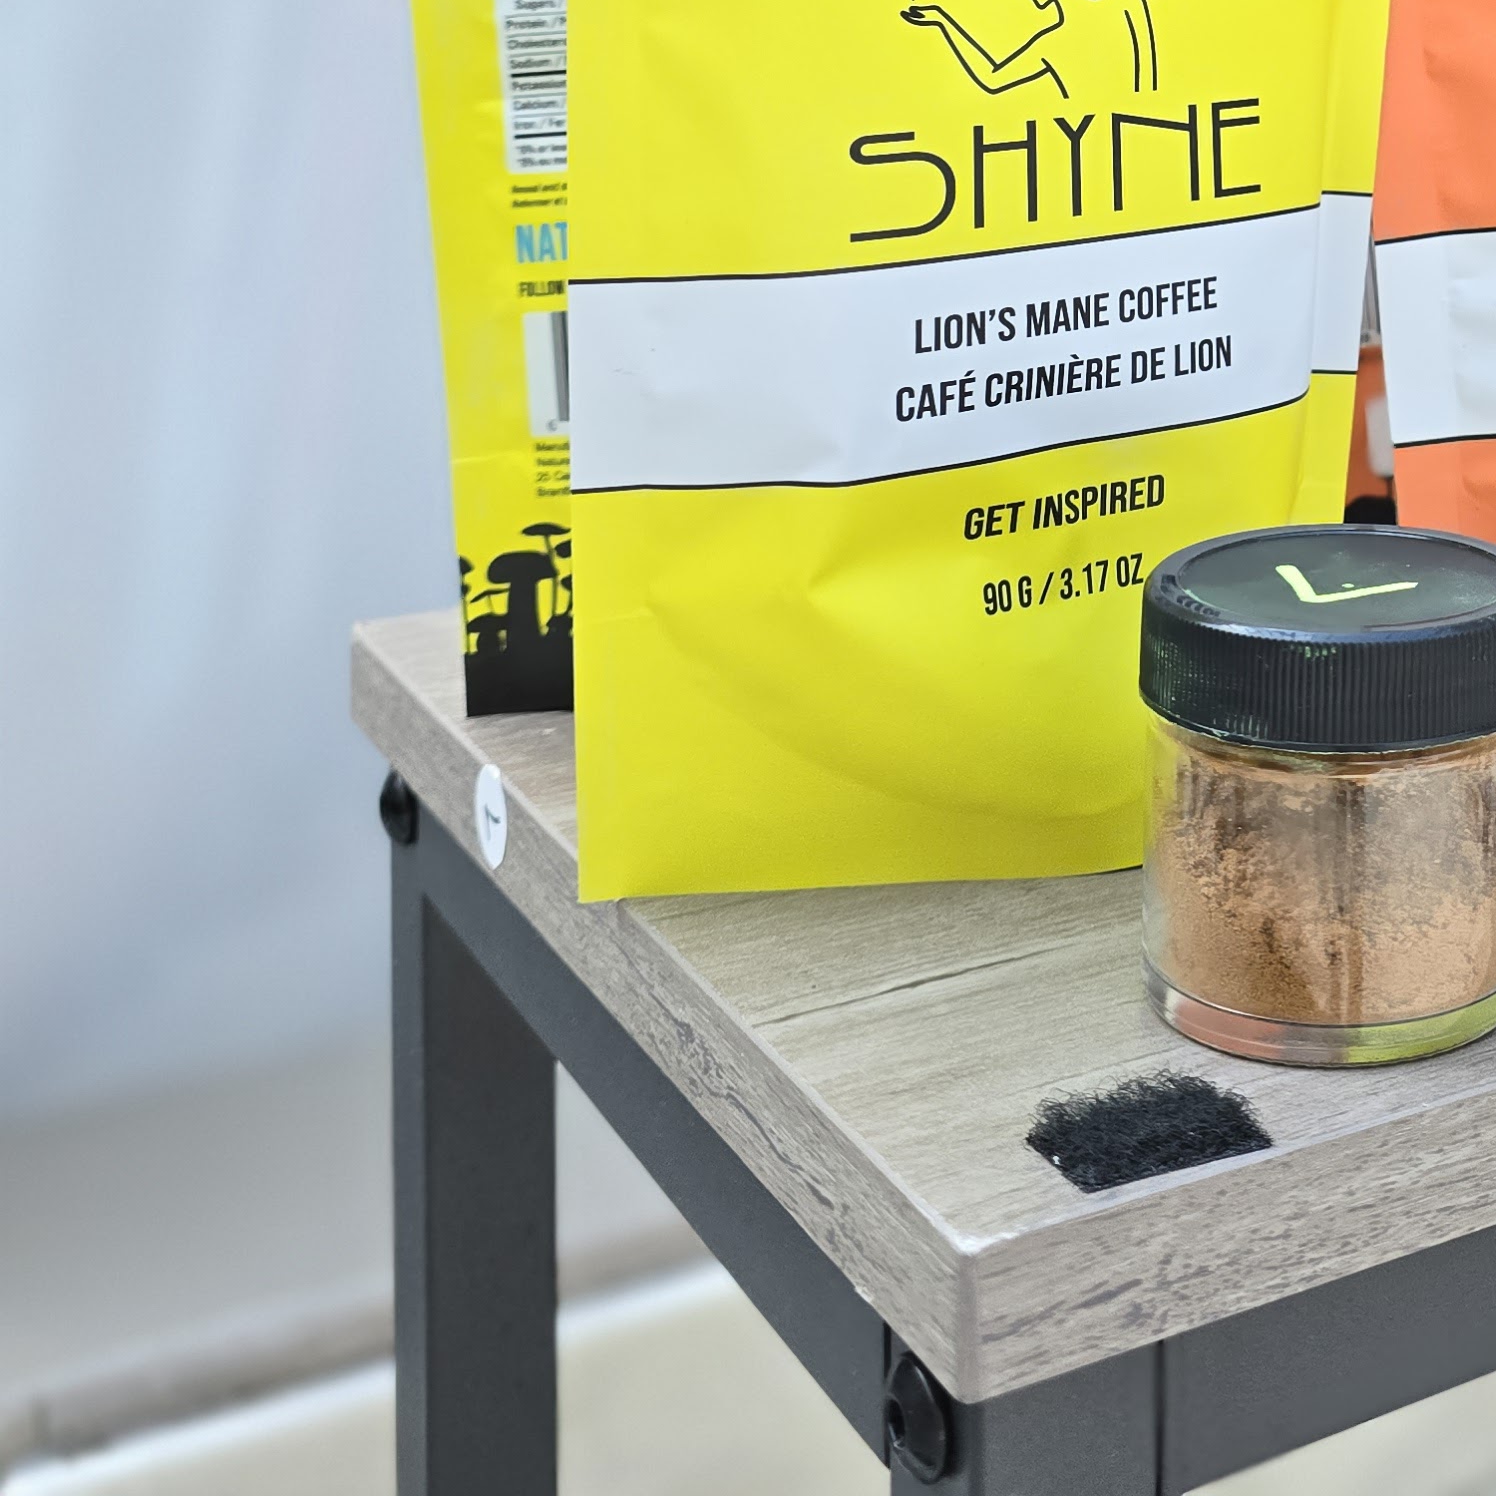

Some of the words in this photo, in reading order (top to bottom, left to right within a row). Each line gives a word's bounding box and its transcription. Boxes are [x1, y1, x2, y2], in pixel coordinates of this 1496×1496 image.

[849, 97, 1262, 242] SHYNE
[914, 307, 1016, 354] LION'S
[1026, 292, 1110, 338] MANE
[1118, 276, 1218, 323] COFFEE
[895, 370, 977, 422] CAFÉ
[985, 354, 1122, 408] CRINIÈRE
[1131, 347, 1166, 384] DE
[1174, 335, 1233, 375] LION
[963, 501, 1026, 541] GET
[1032, 474, 1166, 531] INSPIRED
[983, 580, 1013, 616] 90
[1018, 574, 1033, 609] G
[1038, 571, 1055, 606] /
[1059, 559, 1110, 601] 3.17
[1116, 553, 1144, 587] OZ
